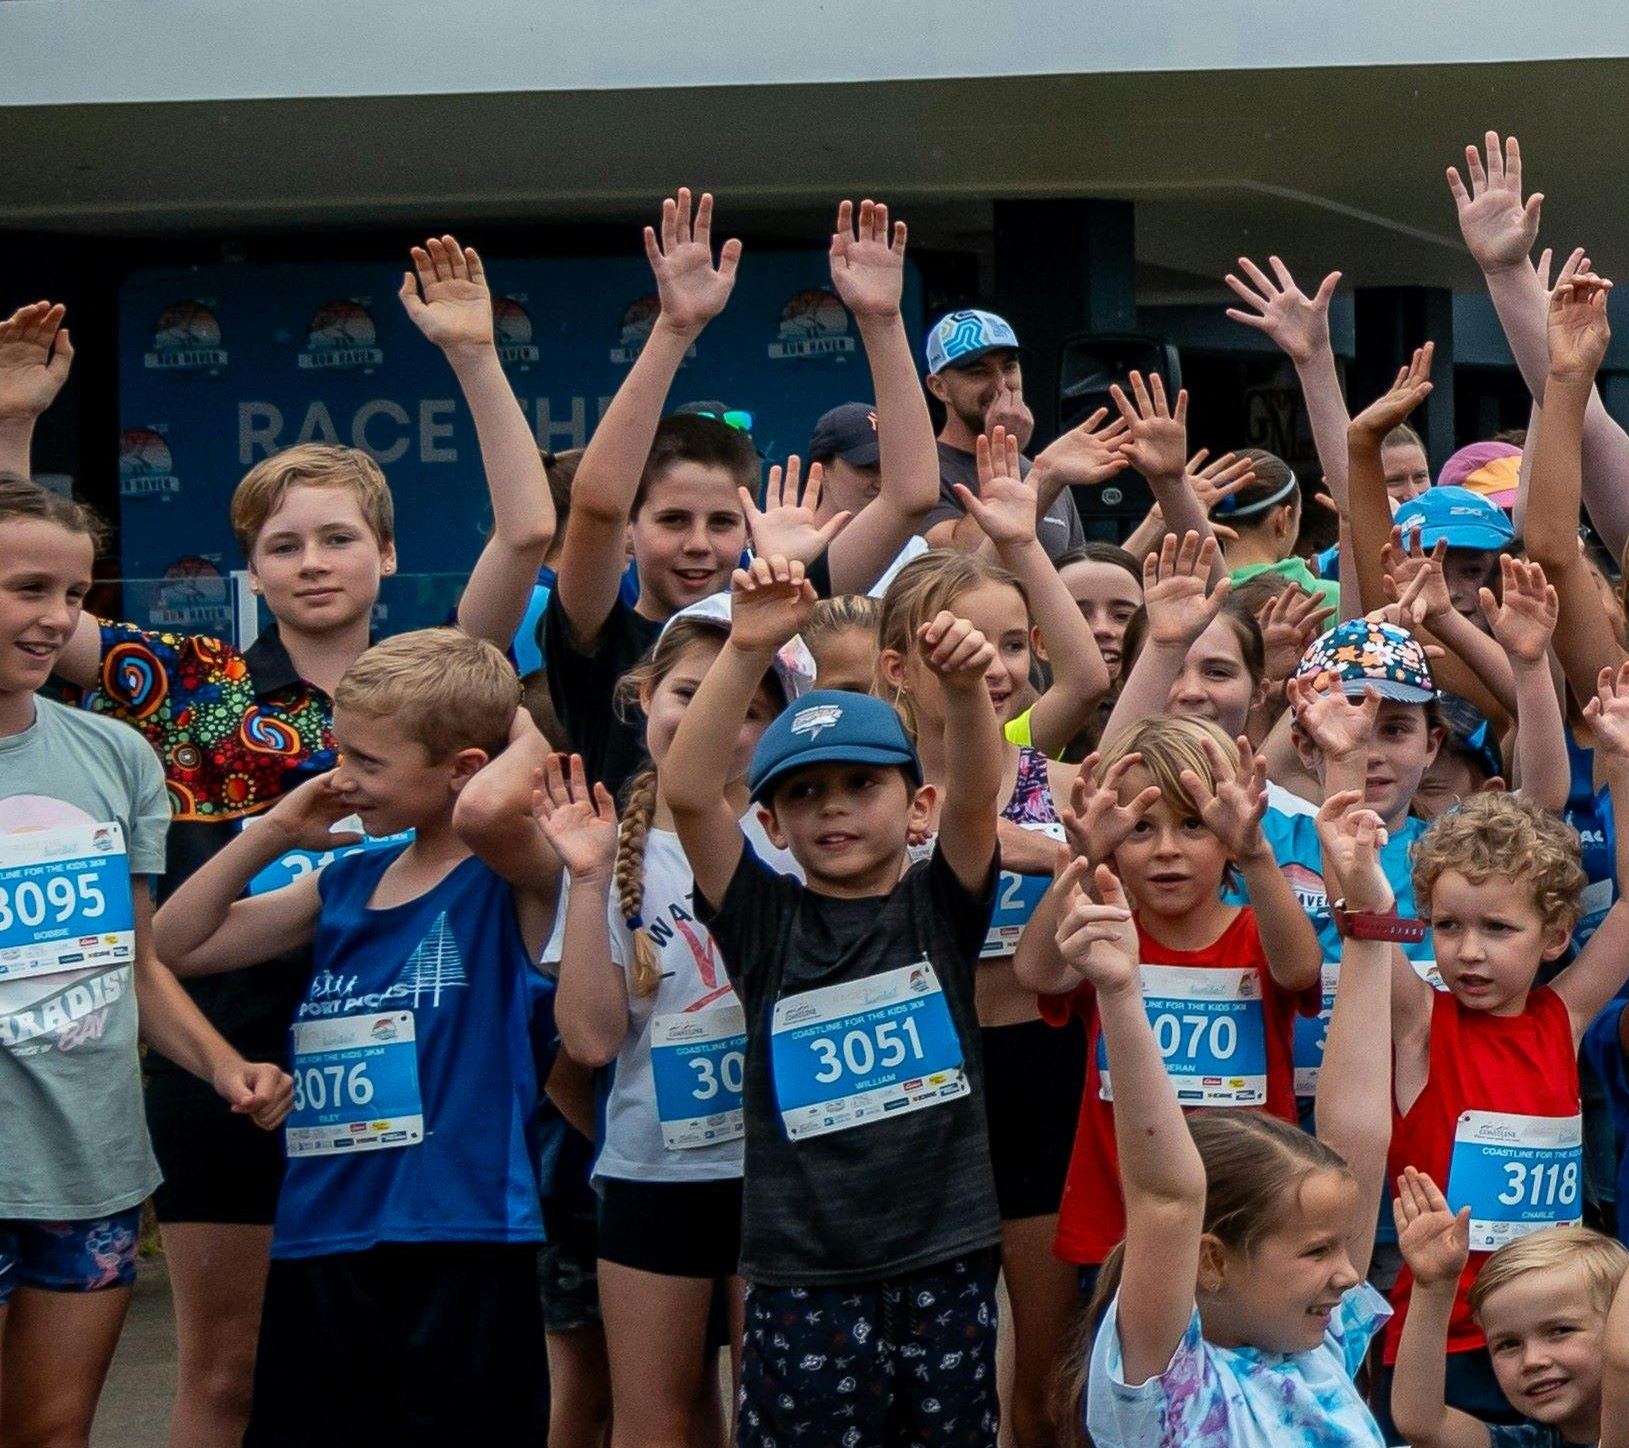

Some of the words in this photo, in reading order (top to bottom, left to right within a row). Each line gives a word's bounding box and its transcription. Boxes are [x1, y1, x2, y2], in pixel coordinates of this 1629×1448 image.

[239, 400, 458, 464] RACE
[844, 1016, 865, 1027] FOR
[867, 1010, 886, 1020] THE
[887, 1004, 908, 1016] KIDS
[1155, 1014, 1237, 1060] 070
[810, 1017, 923, 1083] 3051
[293, 1062, 374, 1111] 3076
[855, 1073, 896, 1089] WILLIAM
[1482, 1147, 1533, 1159] COASTLINE
[1535, 1150, 1553, 1159] FOR
[1554, 1150, 1567, 1159] THE
[1498, 1162, 1577, 1205] 3118
